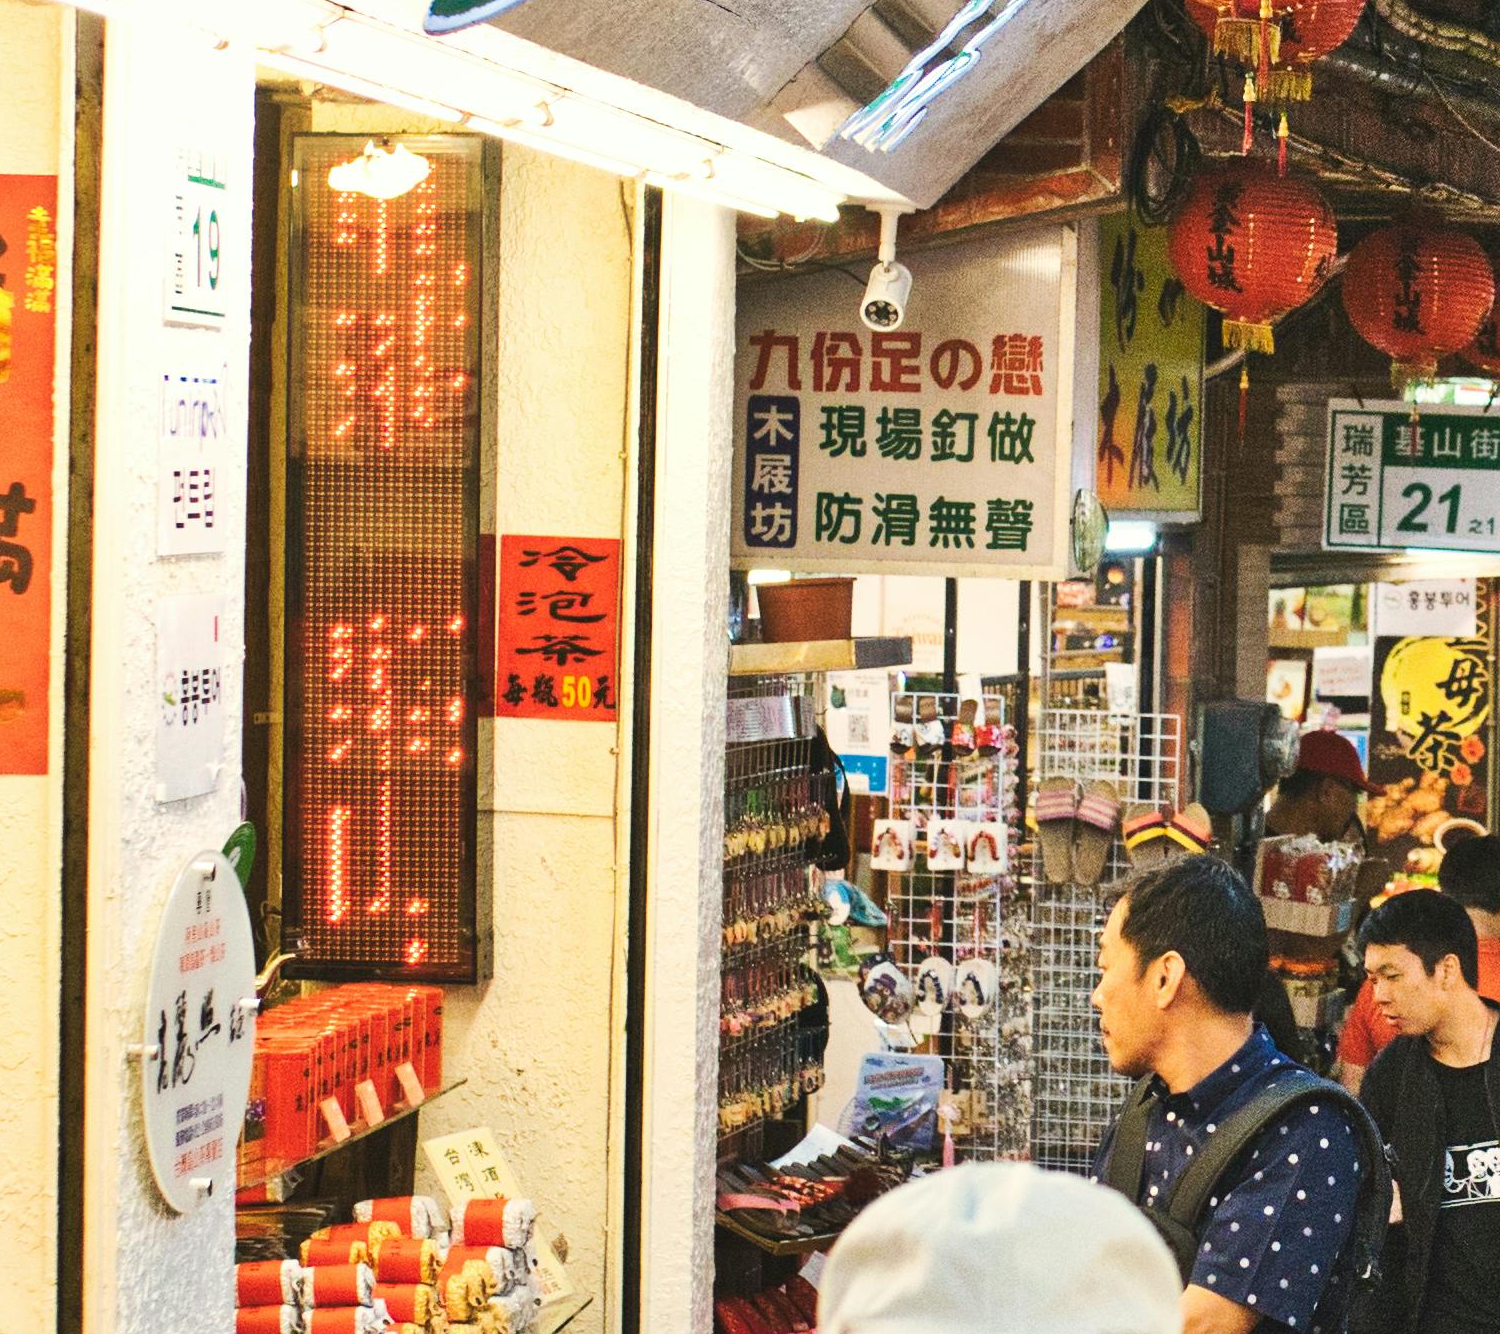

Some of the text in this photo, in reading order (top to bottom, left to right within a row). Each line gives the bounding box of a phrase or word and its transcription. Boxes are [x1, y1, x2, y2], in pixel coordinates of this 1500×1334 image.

[818, 403, 1036, 464] 現場釘做
[1396, 426, 1500, 461] 基山街
[1339, 424, 1374, 536] 瑞芳區
[1396, 482, 1463, 534] 21
[815, 492, 1034, 551] 防滑無聲
[515, 545, 610, 667] 冷泡茶
[1408, 640, 1490, 771] 母茶
